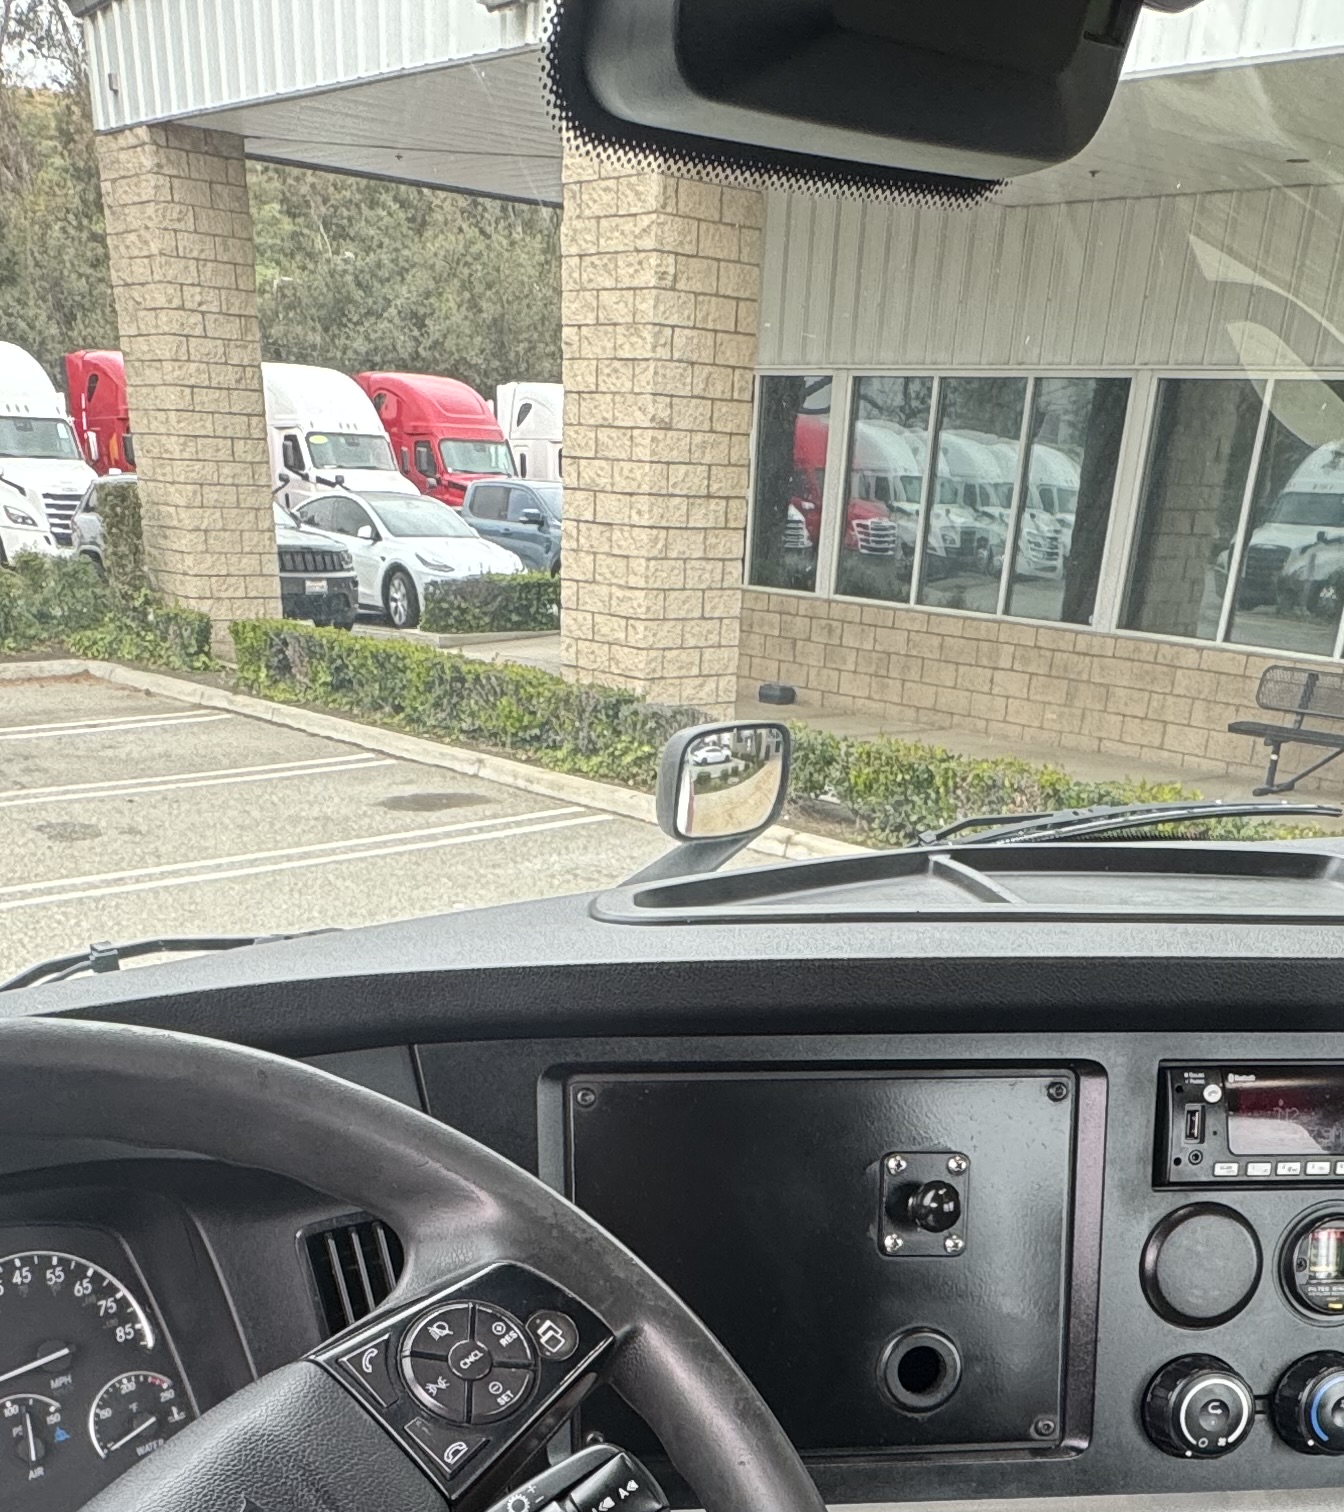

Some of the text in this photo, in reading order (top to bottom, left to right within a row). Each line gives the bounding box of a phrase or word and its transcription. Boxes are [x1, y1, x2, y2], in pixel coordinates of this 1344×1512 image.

[13, 1267, 32, 1285] 45
[46, 1267, 65, 1285] 55
[74, 1281, 92, 1297] 65
[97, 1297, 117, 1316] 75
[116, 1324, 135, 1342] 85
[499, 1330, 518, 1348] RES
[49, 1374, 72, 1390] MPH
[497, 1390, 514, 1406] SET
[4, 1405, 19, 1417] 100
[28, 1467, 45, 1481] AIR
